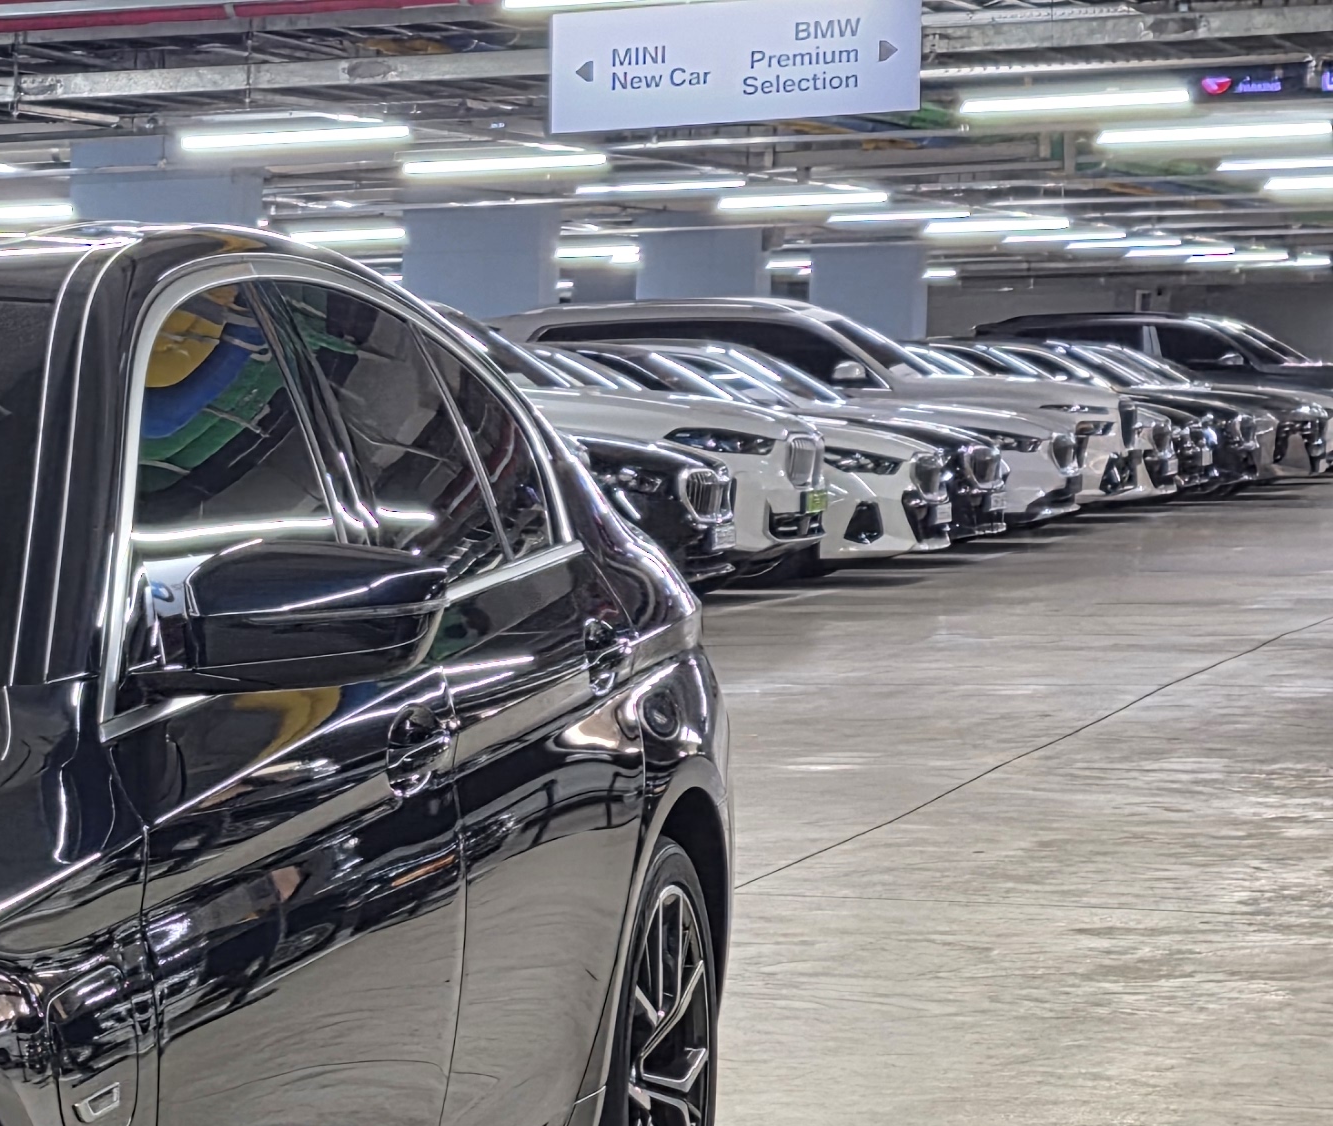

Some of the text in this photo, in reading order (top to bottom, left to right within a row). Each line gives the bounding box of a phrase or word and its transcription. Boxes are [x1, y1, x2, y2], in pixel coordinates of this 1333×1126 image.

[794, 17, 861, 41] BMW
[611, 45, 666, 67] MINI
[750, 46, 859, 69] Premium
[611, 67, 711, 91] New Car
[742, 71, 859, 95] Selection
